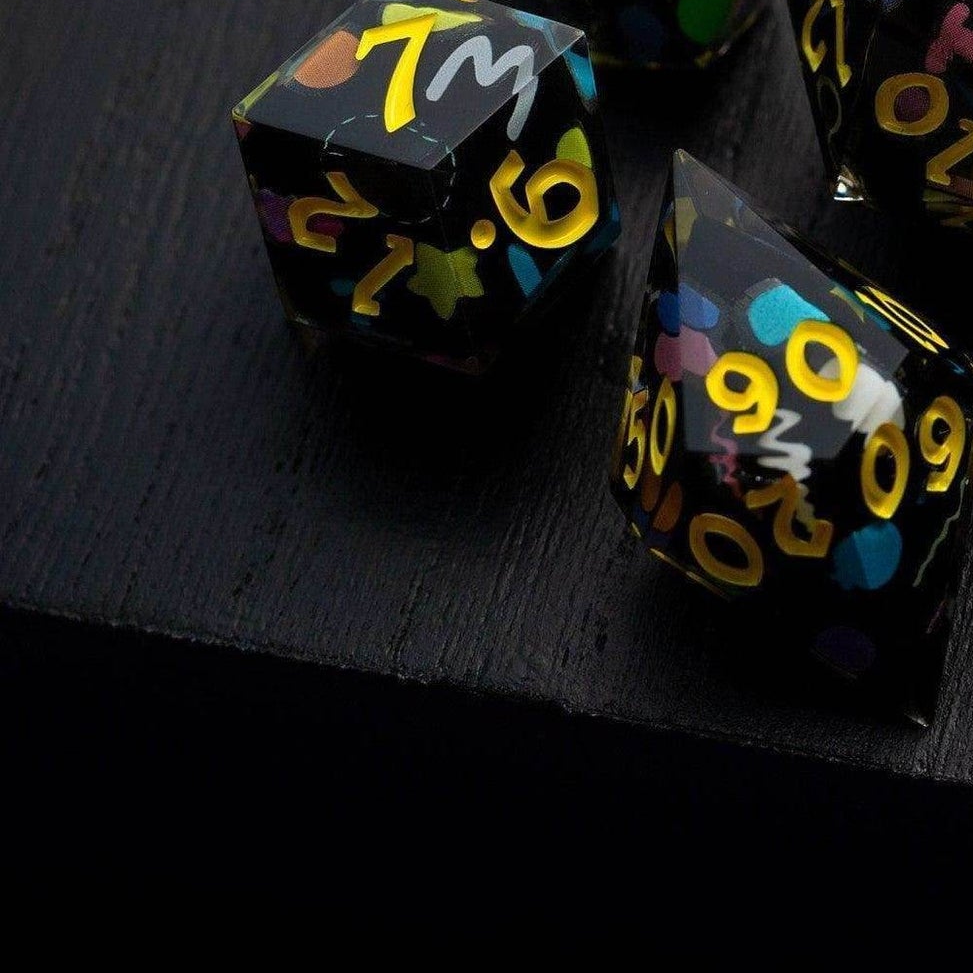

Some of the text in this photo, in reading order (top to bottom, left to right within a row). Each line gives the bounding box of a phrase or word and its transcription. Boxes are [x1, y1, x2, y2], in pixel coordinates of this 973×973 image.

[355, 13, 448, 133] 7
[623, 376, 677, 490] 50
[706, 319, 857, 434] 90
